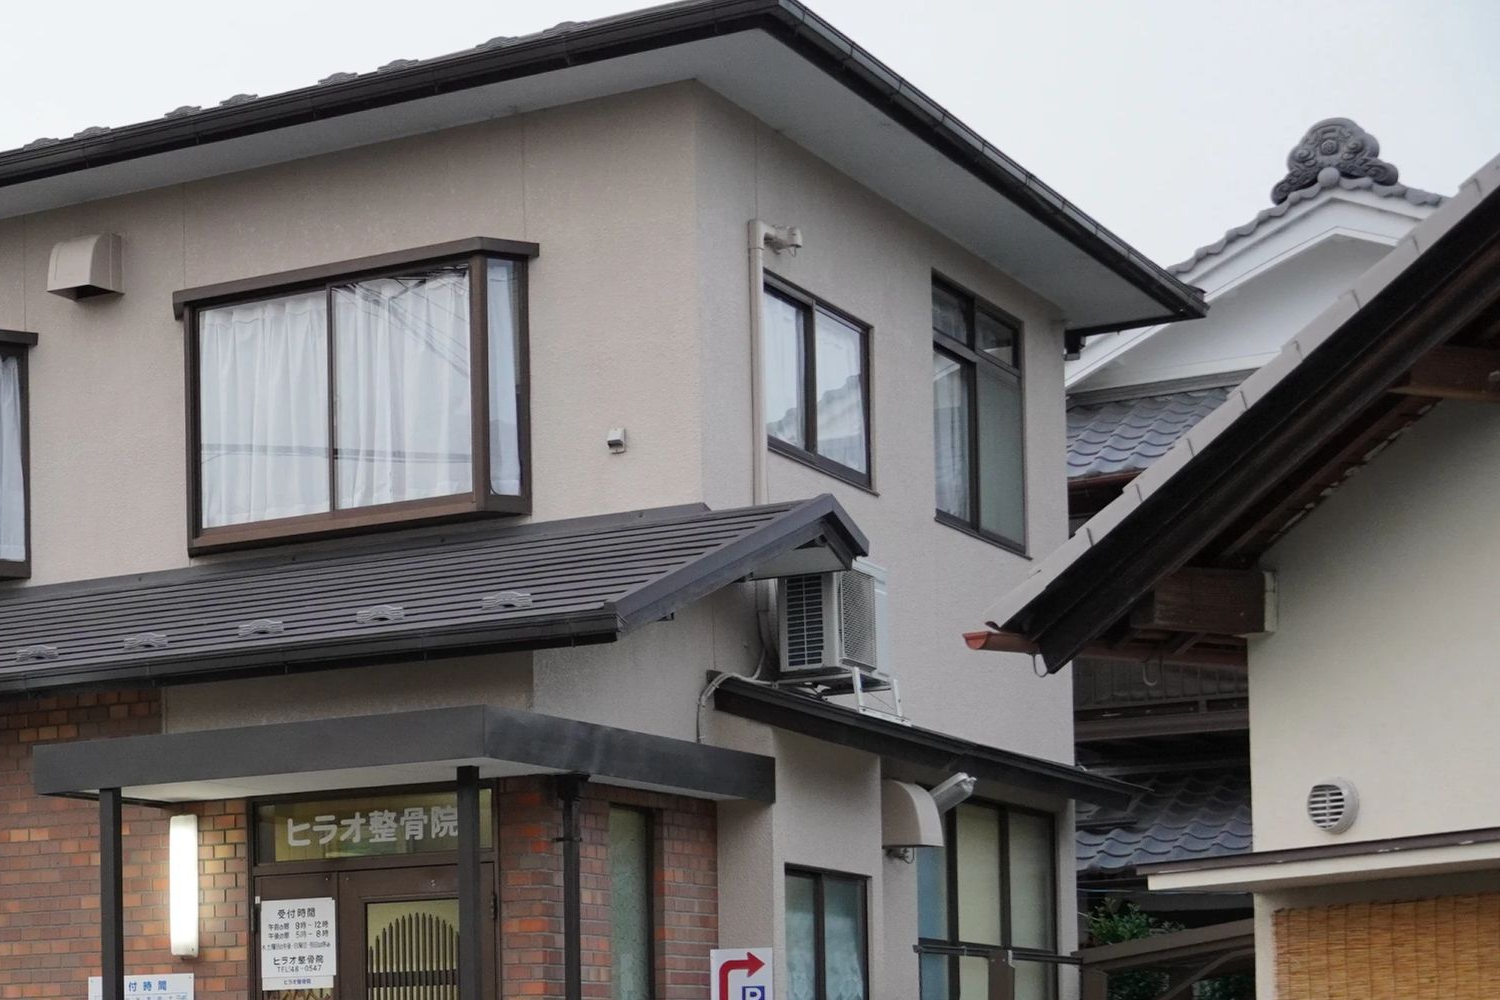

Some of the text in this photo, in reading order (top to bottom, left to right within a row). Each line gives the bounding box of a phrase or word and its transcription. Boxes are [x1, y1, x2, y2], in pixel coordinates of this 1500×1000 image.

[287, 806, 458, 847] ヒラオ整骨院
[277, 907, 316, 919] 受付時間
[128, 980, 167, 992] 付時間
